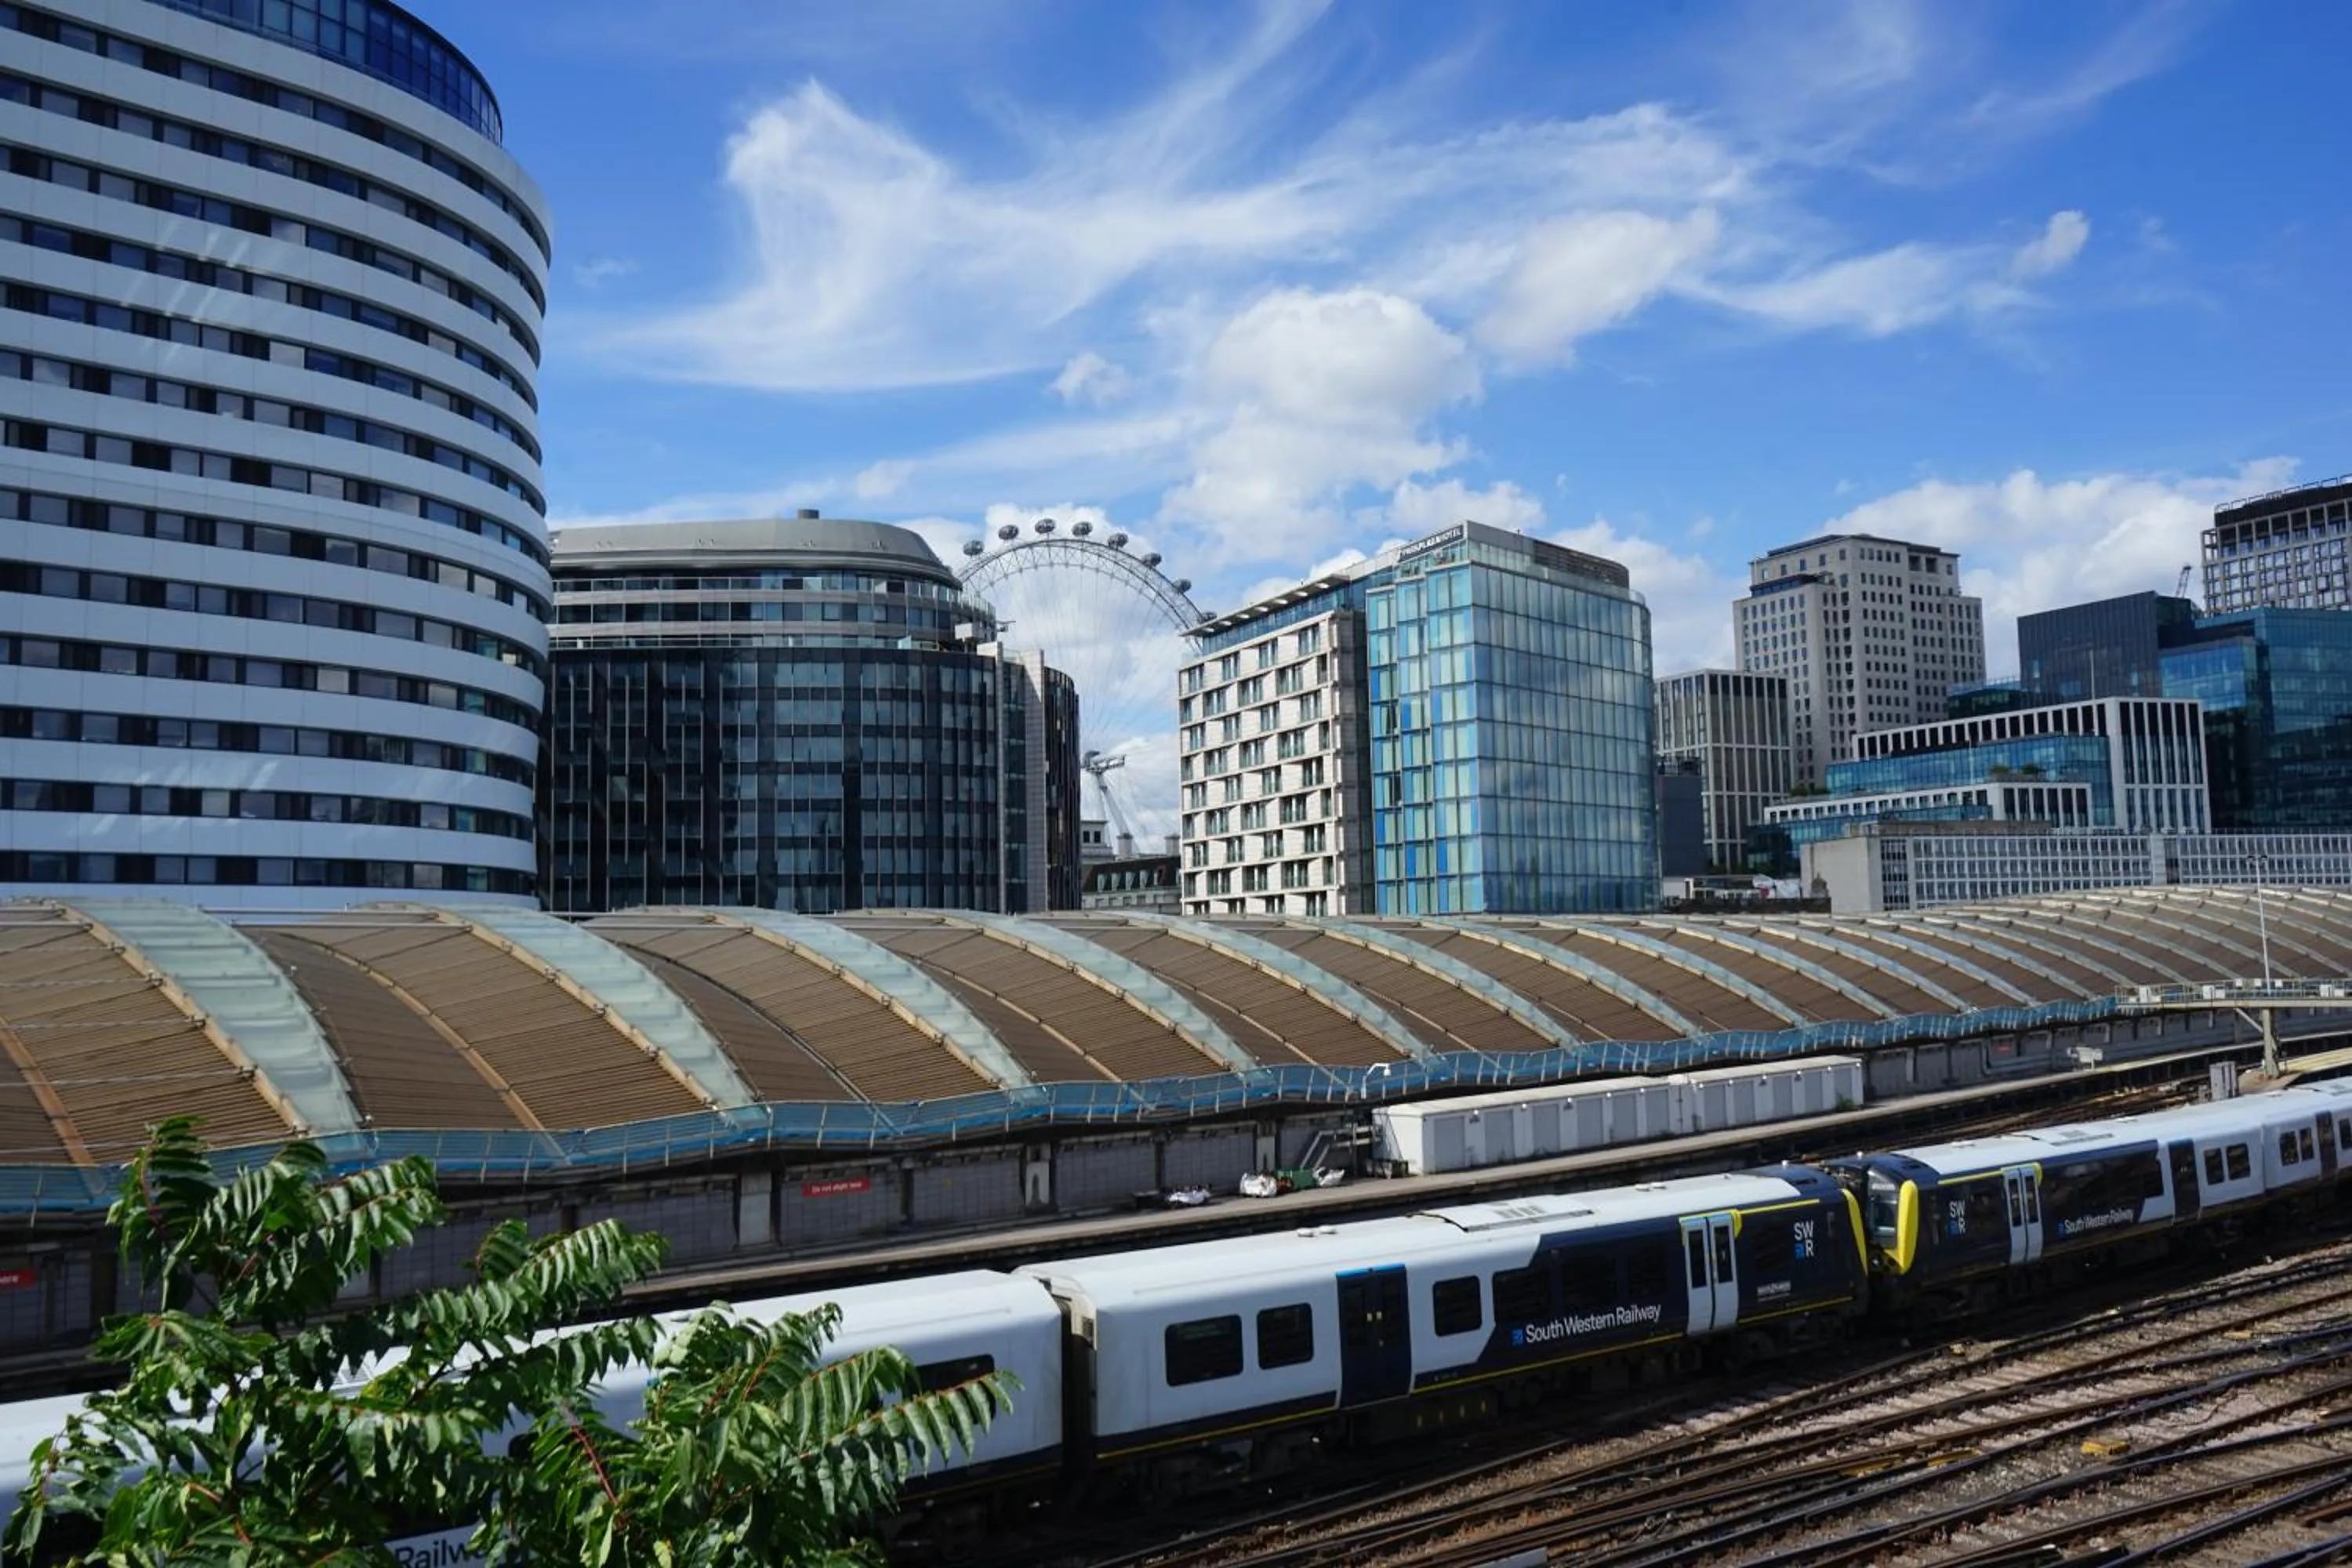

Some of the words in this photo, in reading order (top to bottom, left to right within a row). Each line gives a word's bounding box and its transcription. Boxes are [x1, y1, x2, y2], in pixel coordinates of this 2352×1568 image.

[1949, 1200, 1965, 1218] SW
[1793, 1219, 1814, 1241] SW
[1958, 1217, 1966, 1234] R
[2064, 1217, 2085, 1234] South
[1806, 1239, 1815, 1258] R
[1526, 1317, 1564, 1343] South
[1564, 1312, 1615, 1334] Western
[1616, 1304, 1661, 1325] Railway
[394, 1538, 488, 1568] Railw
